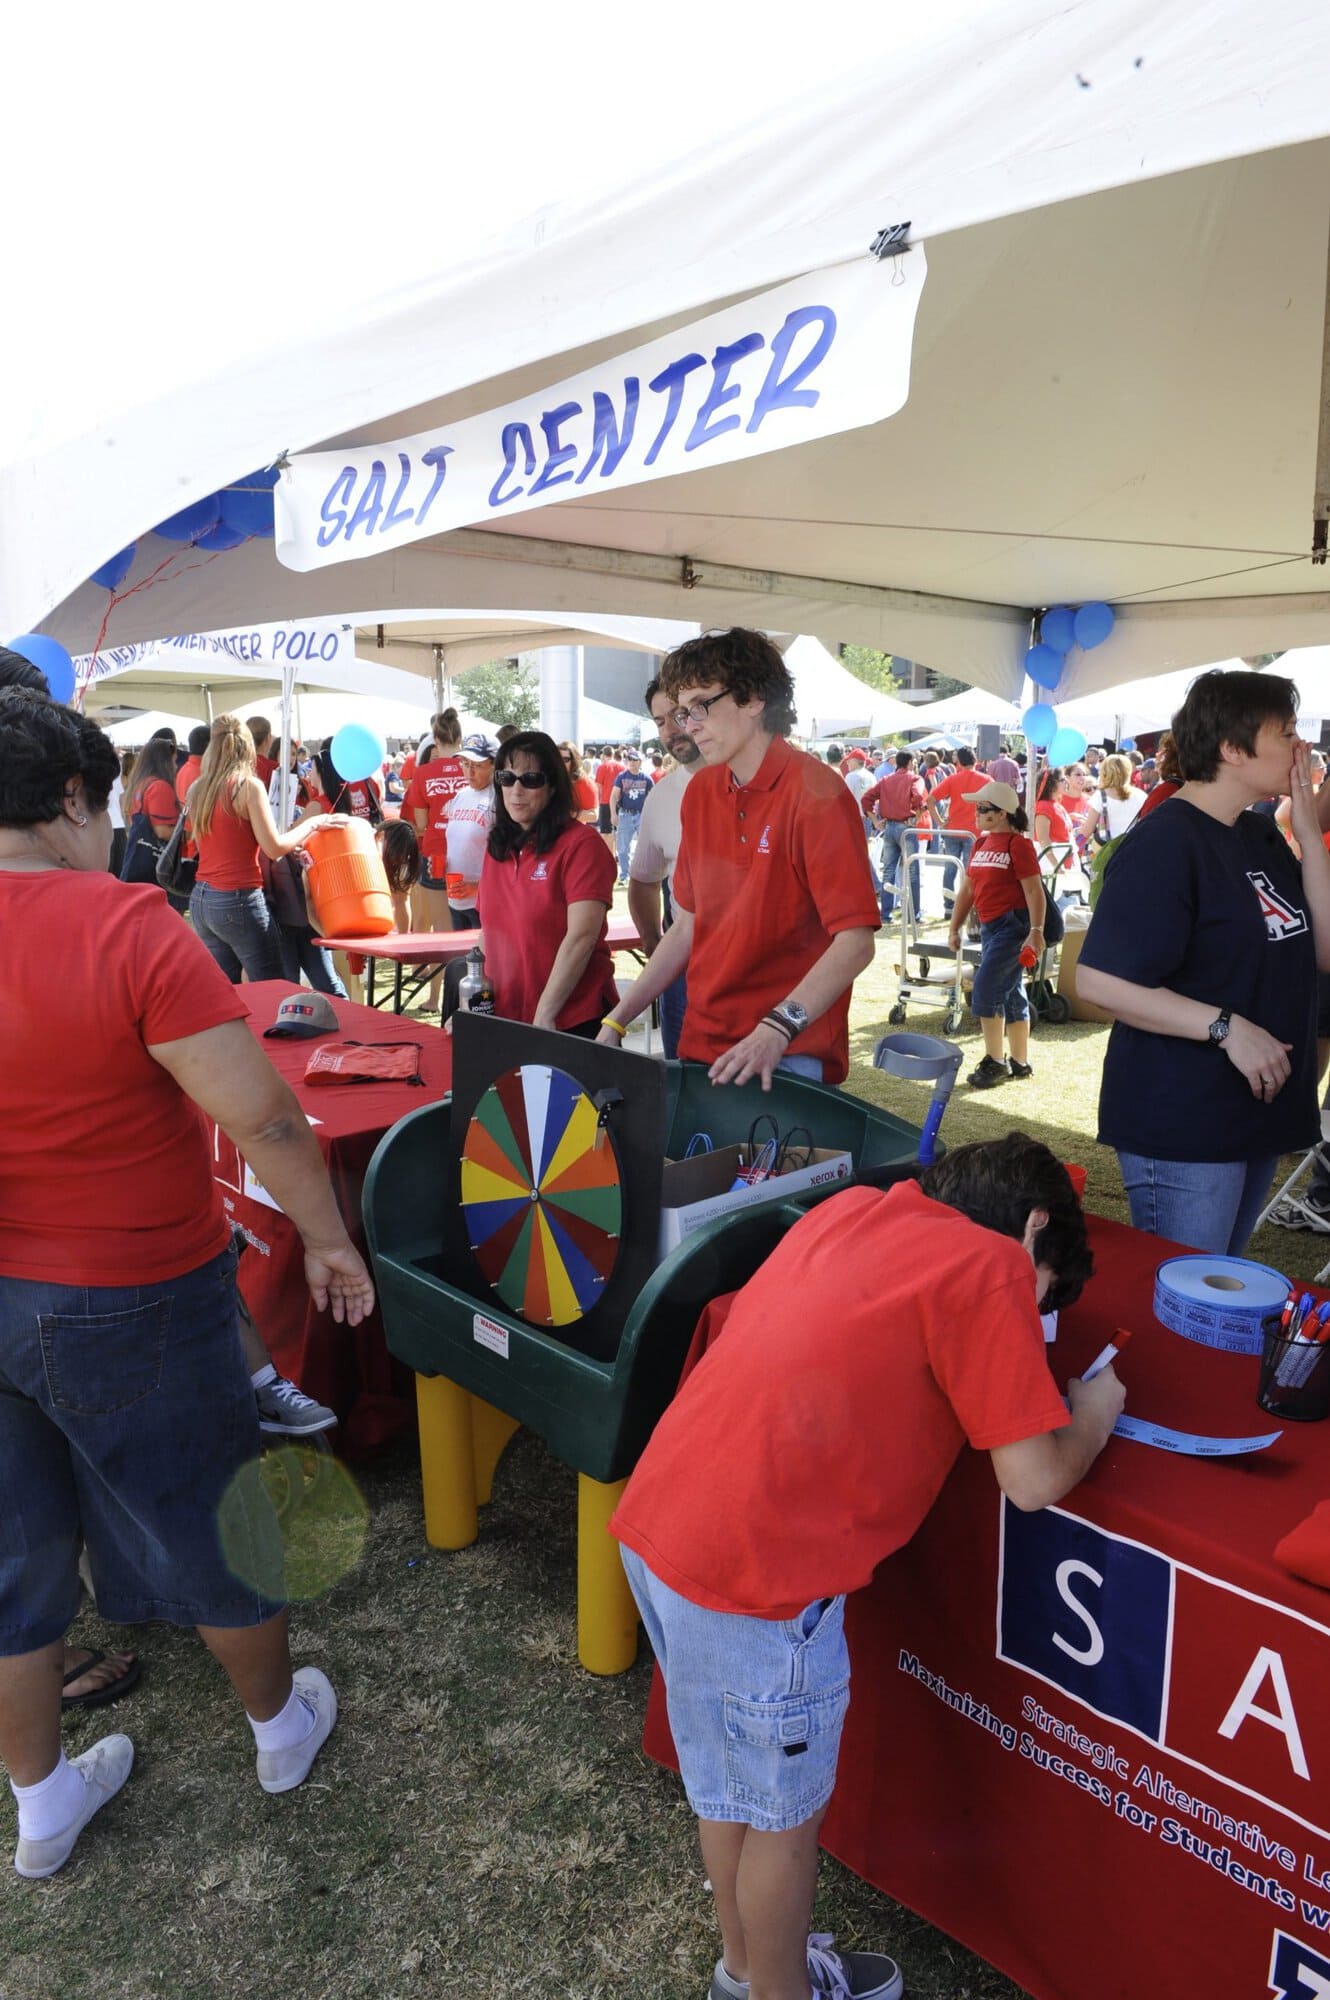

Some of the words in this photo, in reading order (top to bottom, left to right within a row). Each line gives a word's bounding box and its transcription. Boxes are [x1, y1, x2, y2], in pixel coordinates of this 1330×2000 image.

[317, 445, 454, 547] SALT
[488, 304, 838, 509] CENTER
[272, 630, 339, 662] POLO
[810, 1169, 835, 1186] xerox
[480, 1317, 507, 1338] WARNING
[899, 1649, 1017, 1750] Maximizing
[1019, 1732, 1112, 1807] Success
[1115, 1792, 1157, 1833] for
[1160, 1817, 1296, 1912] Students
[1021, 1694, 1129, 1780] Strategic
[1133, 1764, 1297, 1872] Alternative
